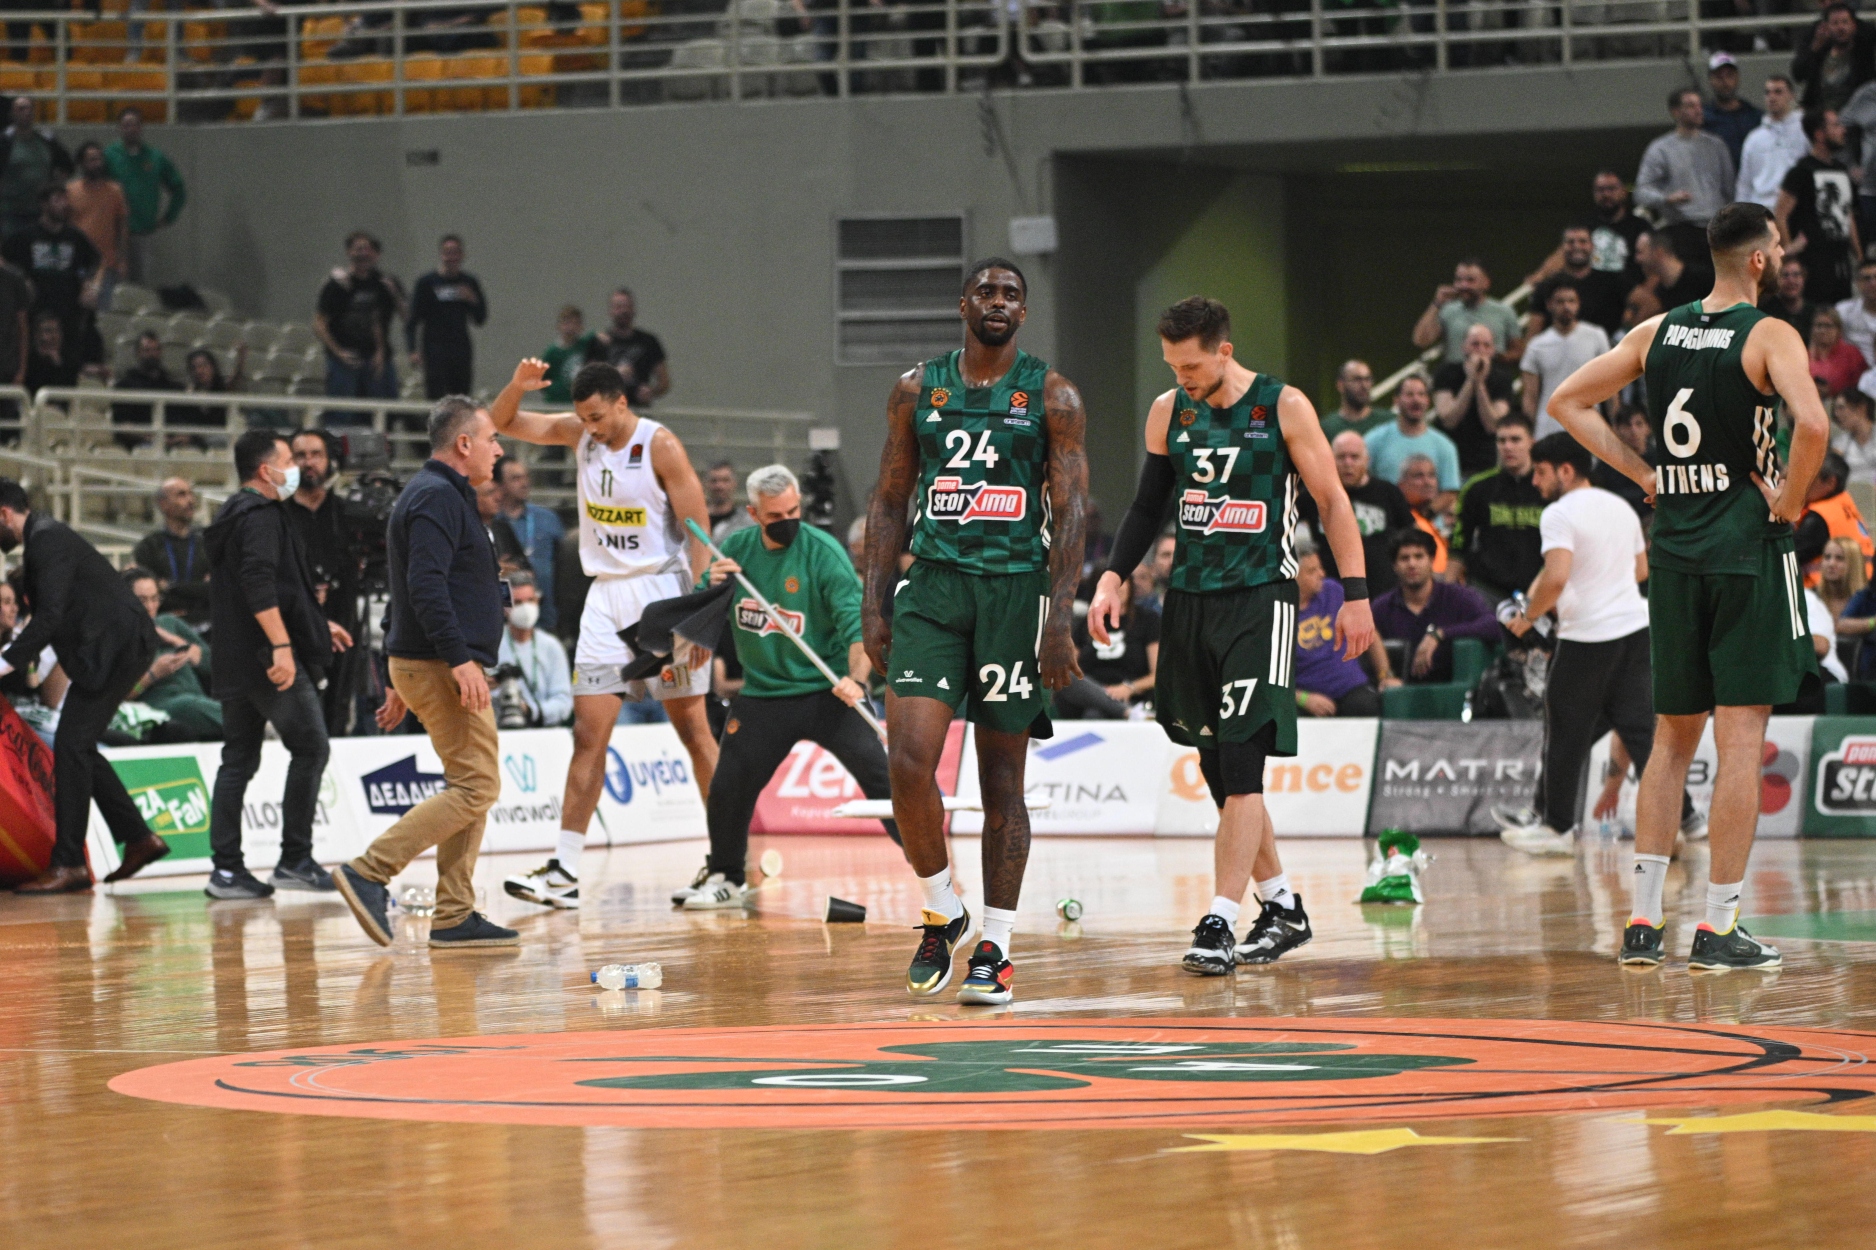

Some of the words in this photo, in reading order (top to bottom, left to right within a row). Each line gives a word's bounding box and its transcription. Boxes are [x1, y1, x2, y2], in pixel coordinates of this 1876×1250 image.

[1663, 388, 1701, 458] 6
[945, 429, 999, 468] 24
[1191, 447, 1241, 484] 37
[600, 469, 613, 498] 11
[1656, 463, 1730, 494] ATHENS
[979, 661, 1033, 702] 24
[1219, 678, 1258, 719] 37
[1385, 758, 1543, 782] MATRI
[1025, 783, 1128, 803] TINA
